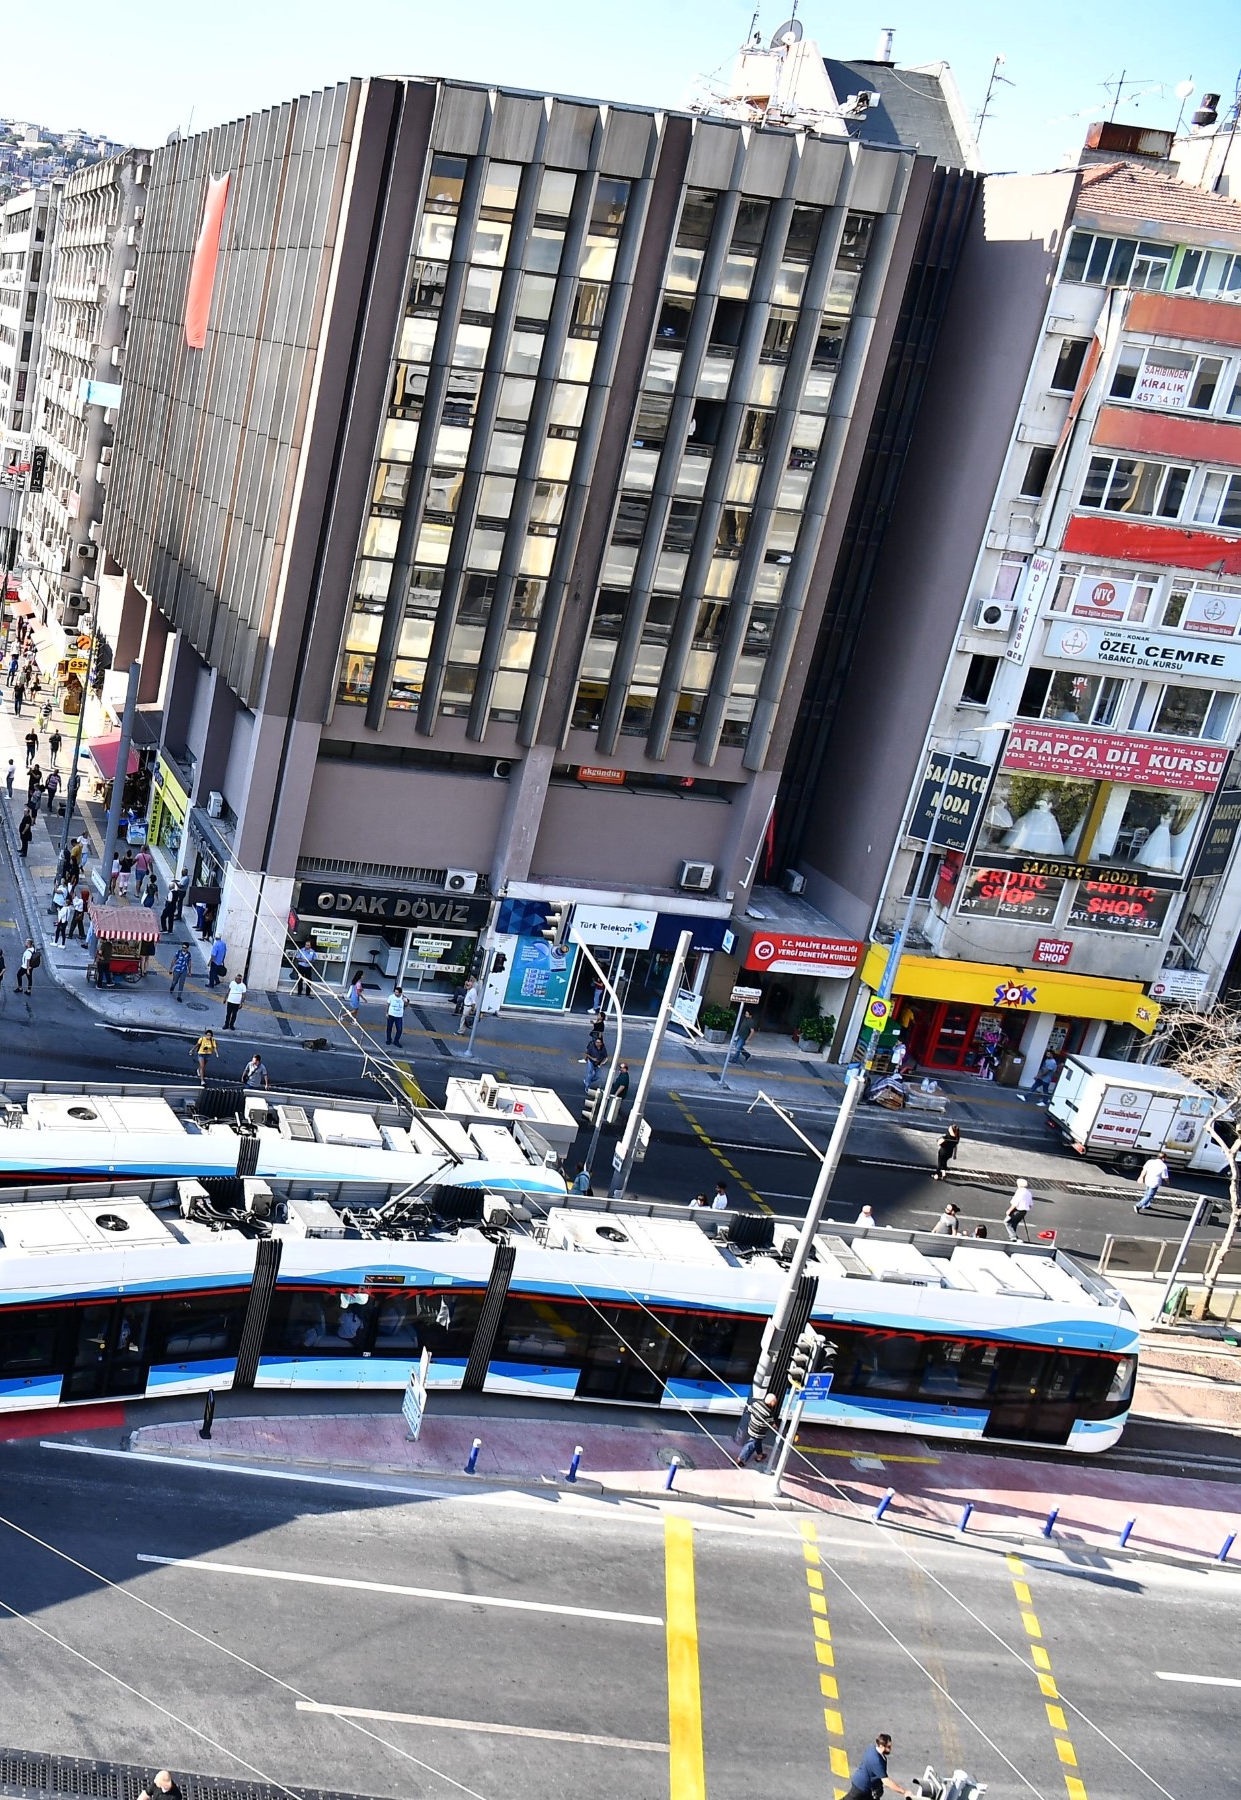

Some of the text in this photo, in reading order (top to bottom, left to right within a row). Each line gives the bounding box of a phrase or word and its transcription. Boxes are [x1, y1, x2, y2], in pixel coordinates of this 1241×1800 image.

[1141, 378, 1185, 392] KİRALIK
[1137, 393, 1154, 402] 457
[1172, 397, 1180, 405] 17
[1093, 587, 1114, 602] NYC
[1013, 606, 1030, 649] KURSU
[1103, 630, 1122, 638] İZMİR
[1127, 634, 1150, 642] KONAK
[1100, 637, 1225, 667] ÖZEL CEMRE
[1098, 652, 1183, 670] YABANCI DİL KURSU
[1025, 730, 1053, 738] CEMRE
[1072, 735, 1090, 743] MAT.
[1128, 742, 1150, 750] TURZ.
[1153, 745, 1170, 753] SAN.
[1173, 747, 1187, 755] TİC.
[1005, 751, 1025, 759] YDS
[1145, 769, 1182, 778] PRATİK
[1106, 747, 1140, 765] DİL
[1148, 754, 1224, 774] KURSU
[1063, 765, 1085, 773] 232
[1099, 869, 1138, 885] MODA
[980, 885, 1036, 904] SHOP
[317, 892, 469, 923] ODAK DÖVİZ
[999, 903, 1019, 912] 425
[1020, 905, 1034, 914] 25
[1087, 897, 1144, 916] SHOP
[580, 921, 633, 933] Türk Telekom
[1106, 915, 1126, 925] 425
[1128, 918, 1141, 927] 25
[782, 939, 858, 953] T.C. MALİYE BAKANLIĞI
[1039, 941, 1070, 954] EROTİC
[777, 948, 857, 962] VERGİ DENETİM KURULU
[1039, 952, 1064, 963] SHOP
